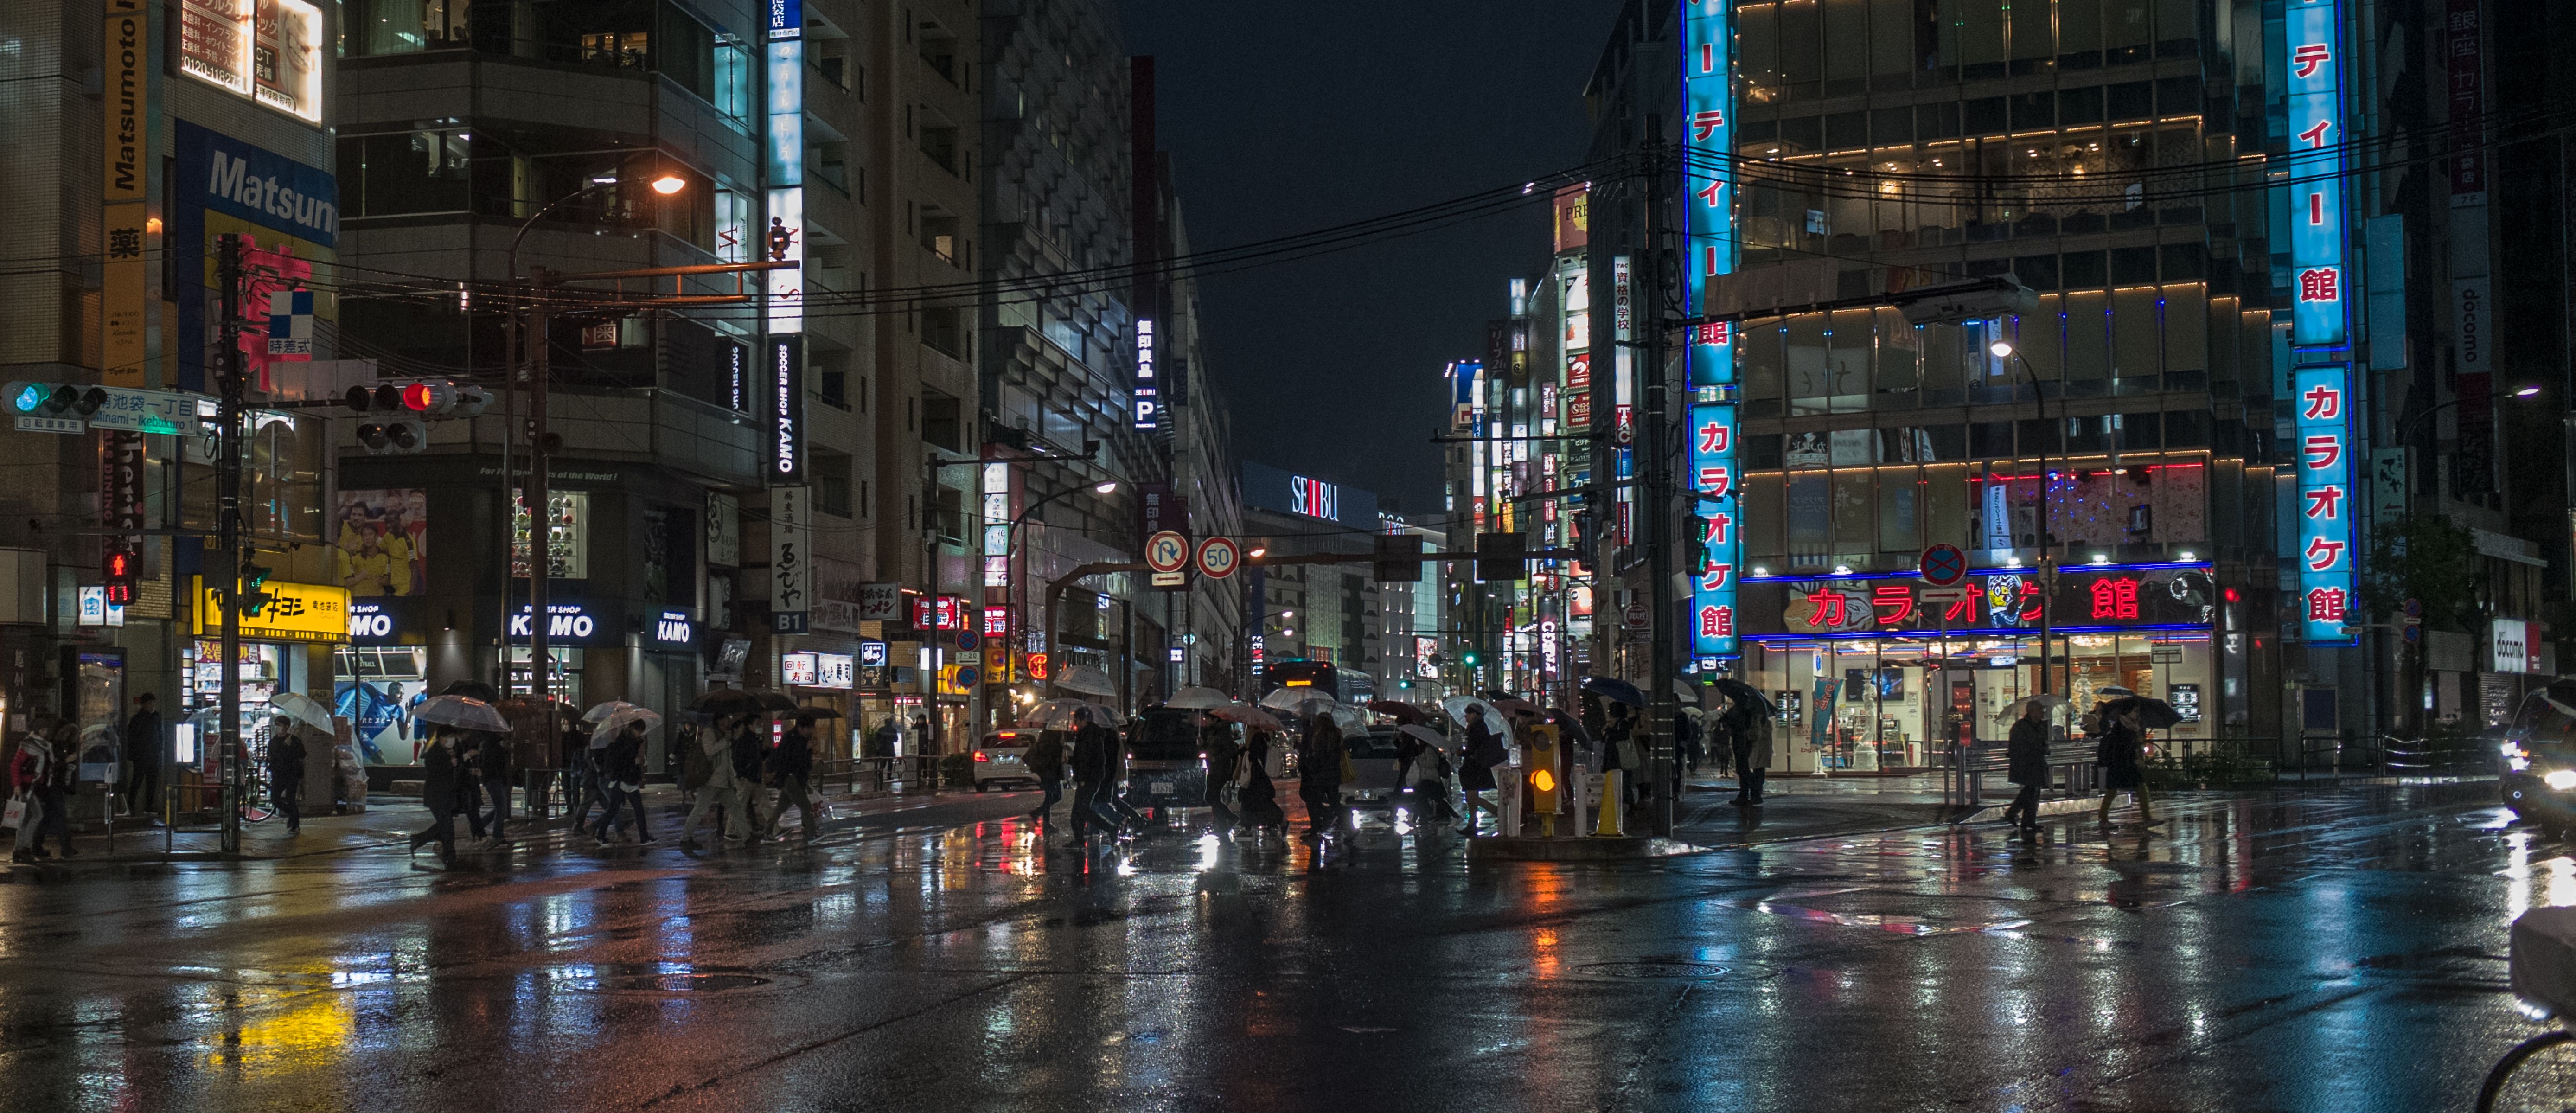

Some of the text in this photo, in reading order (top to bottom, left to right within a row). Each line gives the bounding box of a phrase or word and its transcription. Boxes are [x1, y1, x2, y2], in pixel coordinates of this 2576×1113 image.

[115, 18, 136, 191] Matsumoto
[110, 228, 140, 258] 薬
[1617, 272, 1630, 331] 資格の学校
[2462, 288, 2481, 363] docomo
[269, 339, 311, 353] 時差式
[1137, 320, 1153, 378] 無印良品
[23, 419, 77, 430] 自転車専用
[189, 420, 193, 430] 1
[779, 345, 792, 473] SOCCER SHOP KAMO
[1137, 401, 1153, 421] P
[1617, 407, 1631, 443] TAC
[1292, 475, 1339, 521] SEIBU
[2303, 385, 2348, 622] カラオケ館
[1146, 493, 1160, 538] 無印良
[1697, 422, 1733, 638] カラオケ館
[1206, 549, 1230, 567] 50
[1809, 577, 2138, 627] カラオケ館
[511, 615, 593, 637] KMO
[658, 620, 690, 643] KAMO
[779, 614, 799, 630] B1
[2497, 632, 2524, 659] docomo
[792, 672, 813, 682] 寿司
